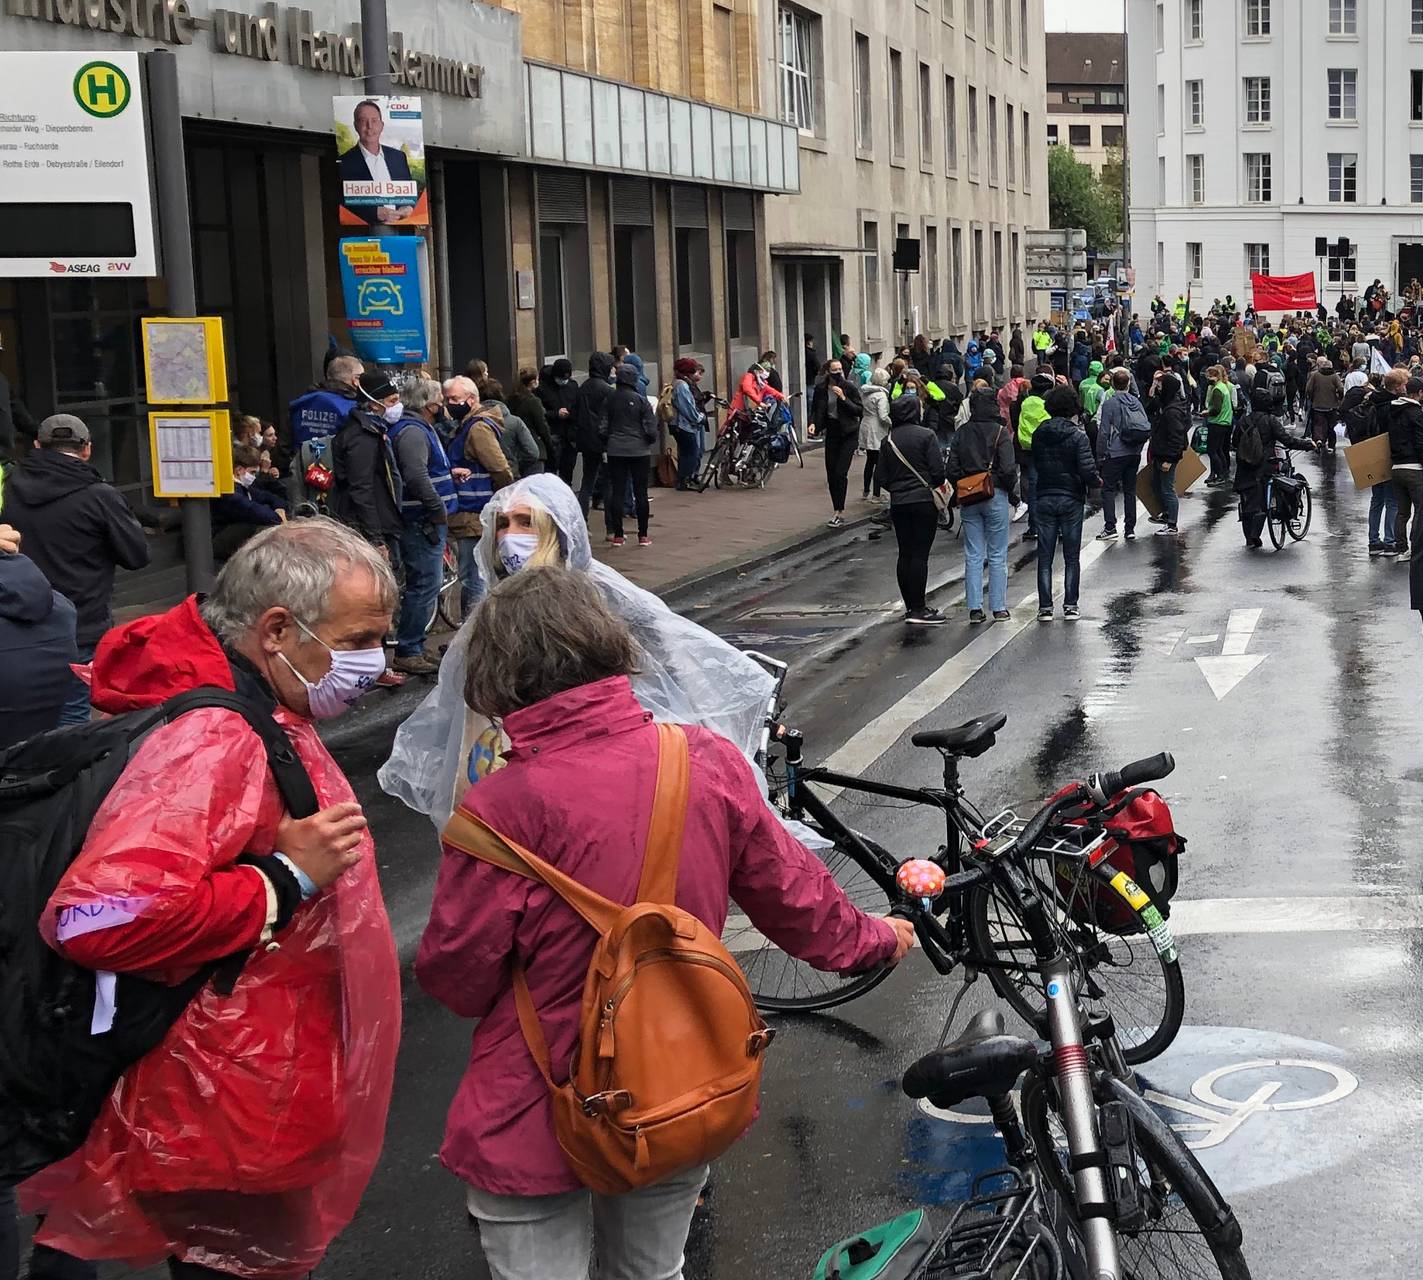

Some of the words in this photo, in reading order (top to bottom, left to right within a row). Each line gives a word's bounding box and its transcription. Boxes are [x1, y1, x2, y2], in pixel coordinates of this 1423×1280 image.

[213, 2, 279, 62] und
[287, 6, 486, 98] Handskammer
[87, 74, 117, 105] H
[24, 125, 39, 133] Weg
[45, 124, 93, 133] Diepenbenden
[24, 142, 59, 150] Fuchserde
[24, 160, 40, 168] Erde
[46, 160, 88, 169] Debyestraße
[94, 160, 124, 168] Eilendorf
[345, 182, 382, 195] Harald
[386, 182, 414, 194] Baal
[67, 265, 100, 273] ASEAG
[301, 409, 338, 423] POLIZEI
